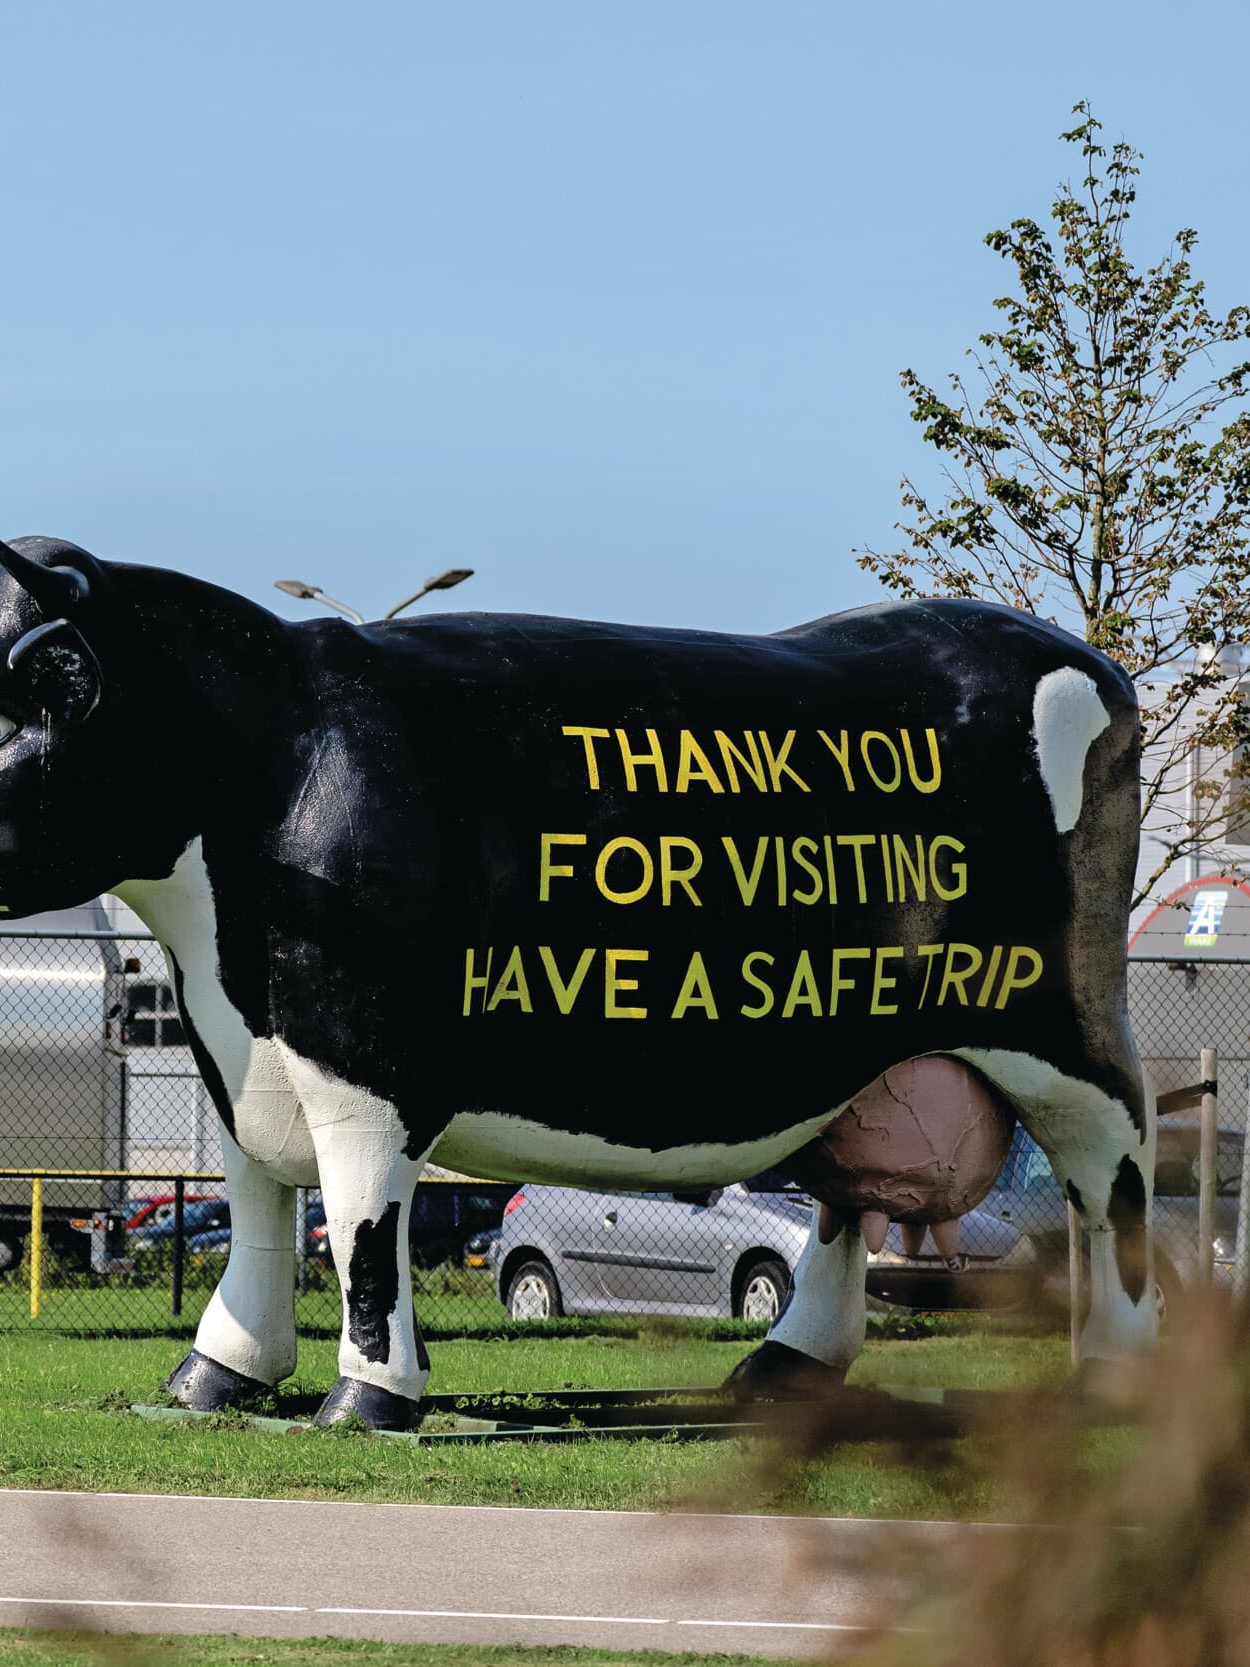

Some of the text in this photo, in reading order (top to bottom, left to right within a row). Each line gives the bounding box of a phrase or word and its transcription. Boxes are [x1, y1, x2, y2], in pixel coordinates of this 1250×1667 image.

[562, 725, 942, 794] THANK YOU
[539, 833, 967, 907] FOR VISITING
[462, 943, 1043, 1020] HAVE A SAFE TRIP
